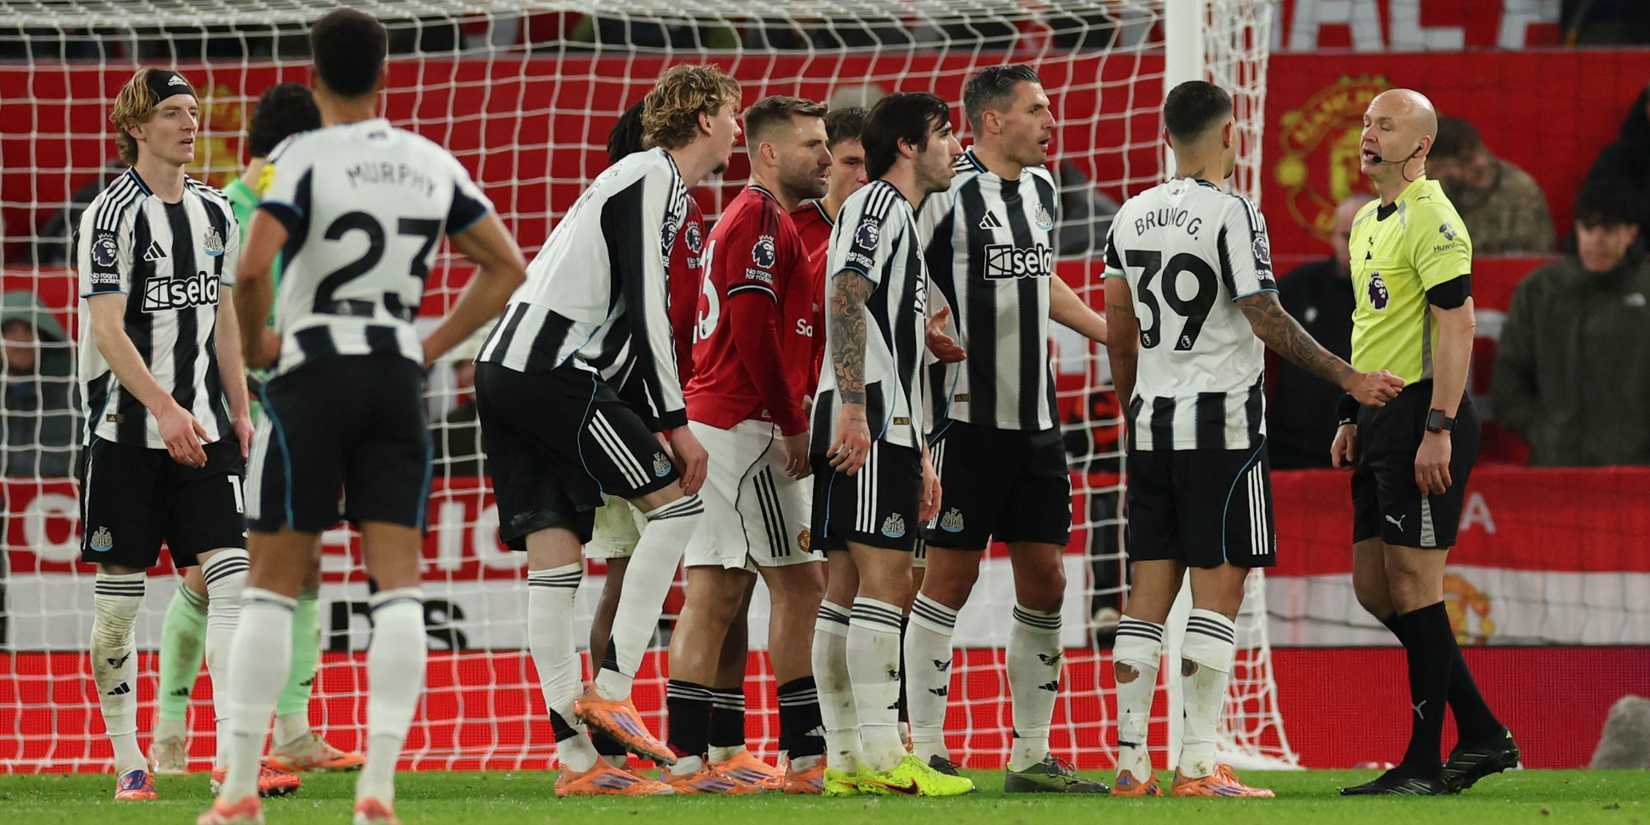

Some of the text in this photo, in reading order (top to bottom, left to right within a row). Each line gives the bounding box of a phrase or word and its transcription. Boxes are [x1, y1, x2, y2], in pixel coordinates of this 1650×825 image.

[346, 162, 436, 197] MURPHY
[1134, 207, 1203, 241] BRUNO G.
[312, 211, 443, 323] 23
[170, 274, 219, 306] sela
[1124, 249, 1219, 351] 39
